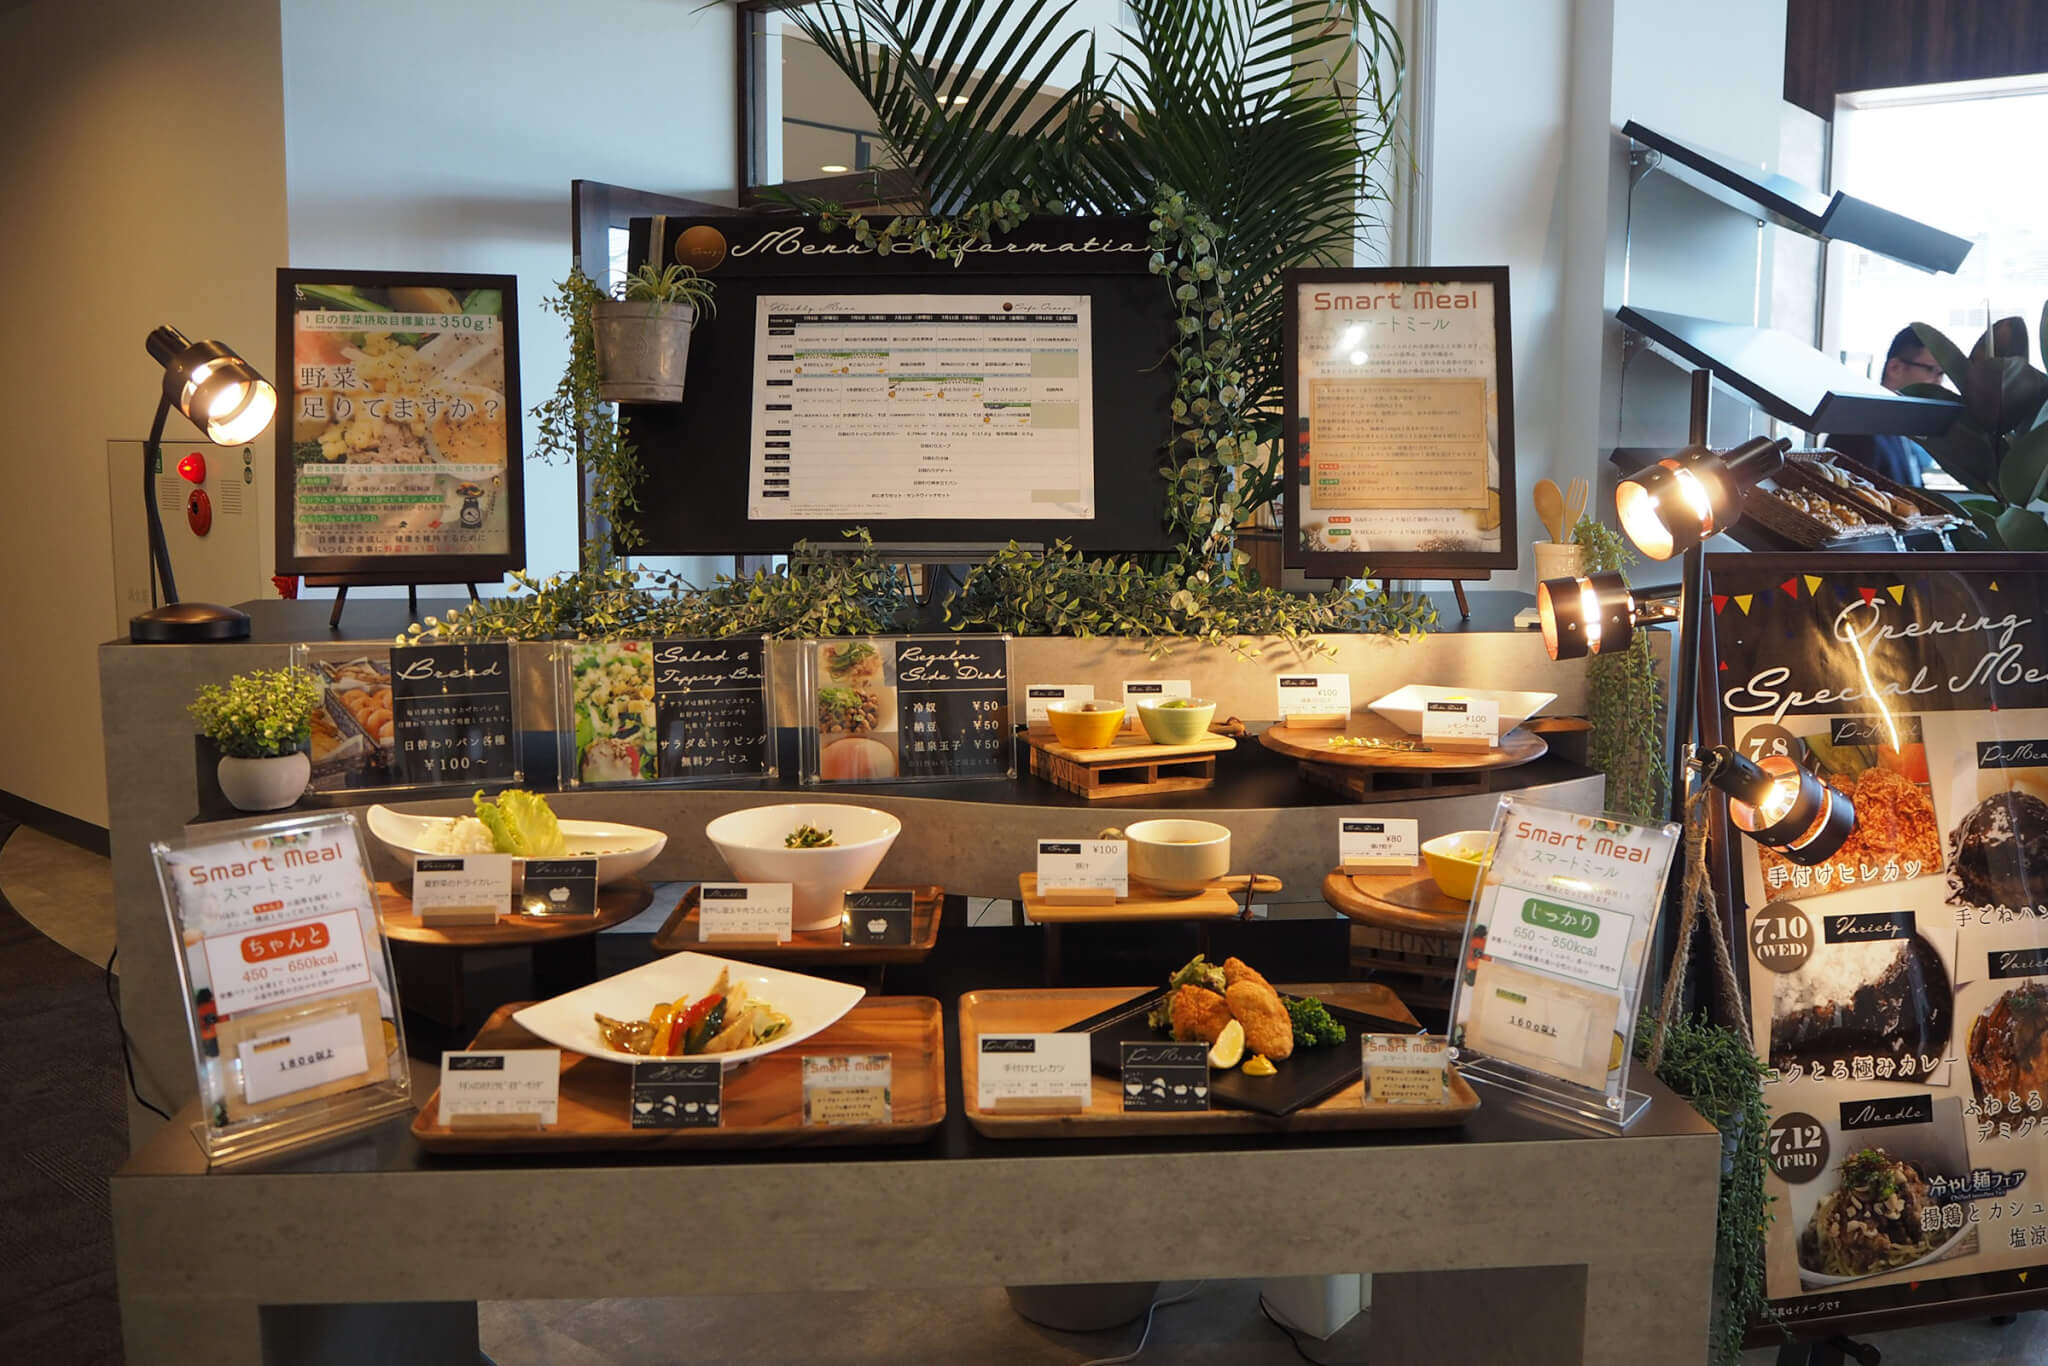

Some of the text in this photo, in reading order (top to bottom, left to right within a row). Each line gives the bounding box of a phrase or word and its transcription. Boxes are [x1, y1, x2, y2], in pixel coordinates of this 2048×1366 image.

[732, 226, 874, 257] Menu
[1314, 290, 1478, 311] Smart Meal
[301, 366, 371, 390] 野菜、
[302, 397, 499, 419] 足りてますか？
[1833, 598, 2034, 657] Opening
[654, 646, 730, 664] Salad
[396, 657, 502, 681] Bread
[900, 666, 1007, 682] Side Dish
[972, 700, 999, 713] ¥50
[1724, 666, 1938, 724] Special
[972, 720, 999, 732] ¥50
[974, 740, 1000, 750] ¥50
[1093, 845, 1118, 854] ¥100
[1515, 822, 1651, 865] Smart Meal
[189, 842, 343, 886] Smart Meal
[1530, 849, 1620, 878] スマートミール
[1767, 859, 1923, 889] 手付けヒレカツ
[223, 873, 324, 903] スマートミール
[1529, 903, 1595, 933] しっかり
[1836, 916, 1903, 938] Variety
[248, 927, 326, 957] ちゃんと
[1513, 926, 1537, 942] 650
[1551, 935, 1600, 958] 850kcal
[1754, 917, 1809, 944] 7.10
[1756, 942, 1808, 960] (WED)
[243, 967, 268, 983] 450
[1369, 1043, 1408, 1053] Smart
[811, 1063, 849, 1074] Smart
[1763, 1054, 1960, 1086] コクとろ極みカレー
[1769, 1125, 1823, 1154] 7.12
[1777, 1153, 1818, 1170] (FRI)
[1929, 1168, 2026, 1198] 冷やし麺フェア
